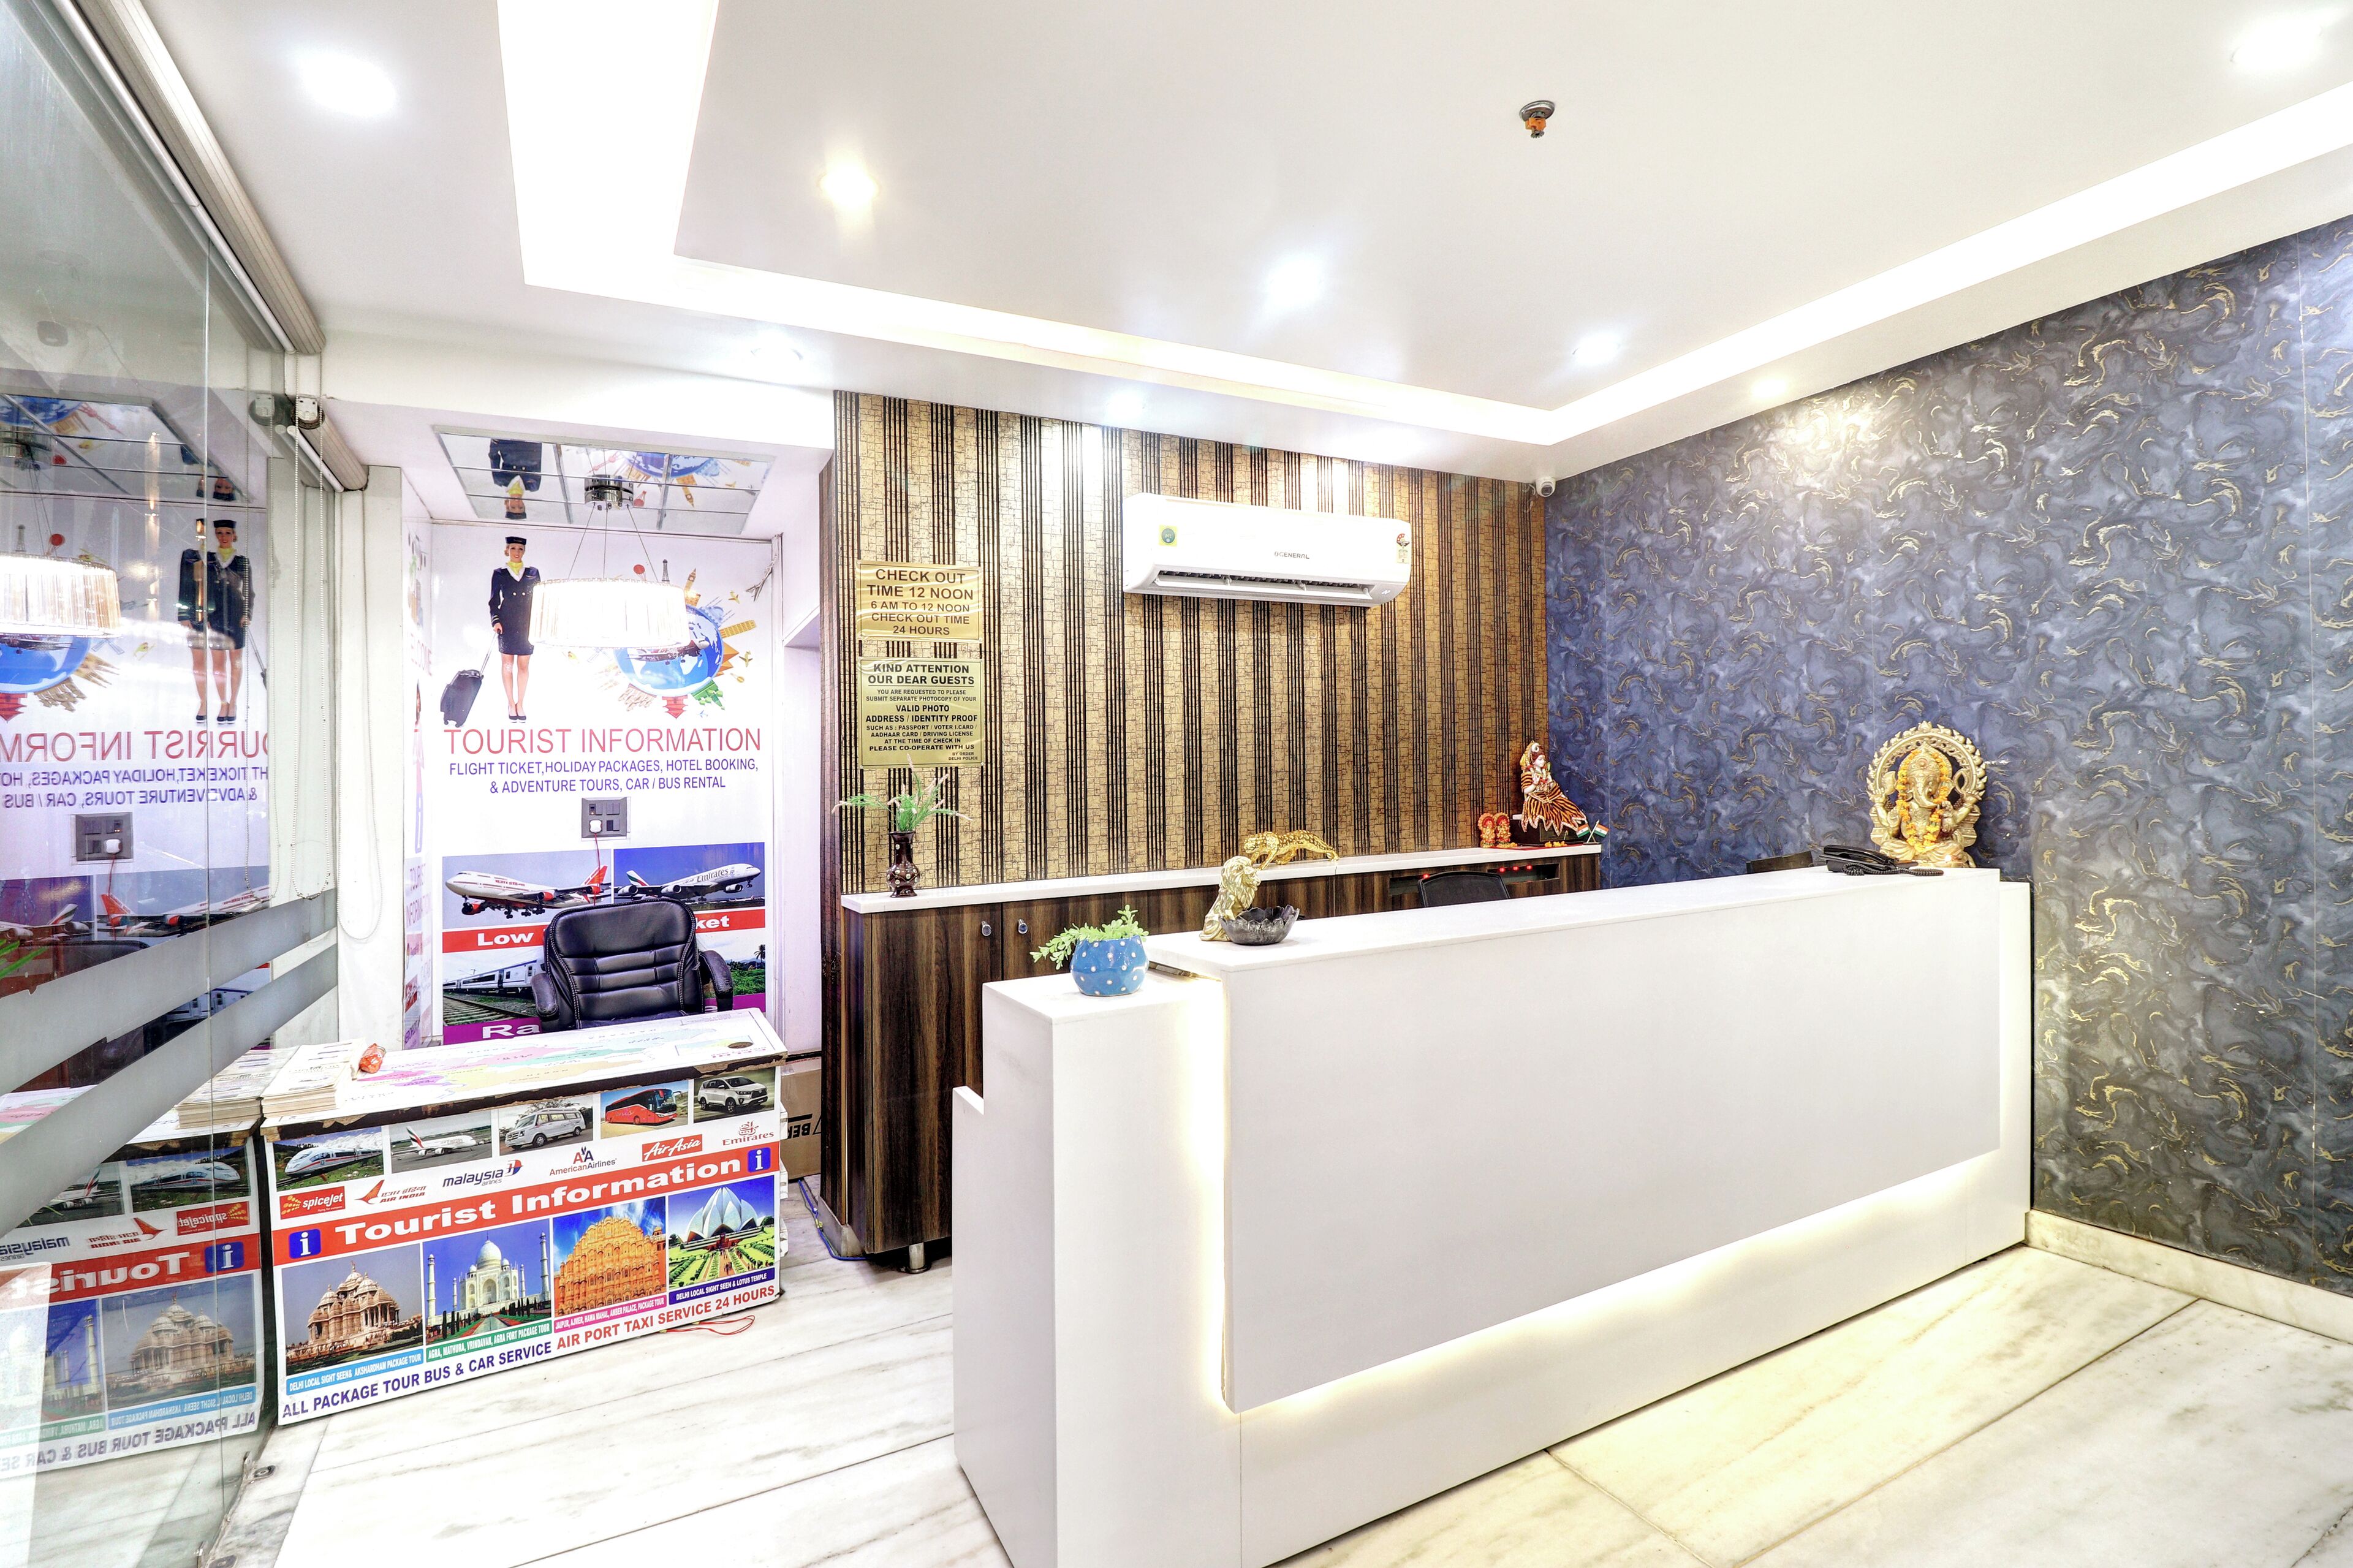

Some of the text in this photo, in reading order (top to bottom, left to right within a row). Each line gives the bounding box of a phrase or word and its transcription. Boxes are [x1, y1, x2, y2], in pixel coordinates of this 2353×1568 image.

[876, 569, 965, 583] CHECK OUT
[867, 585, 973, 600] TIME 12 NOON
[872, 613, 913, 622] CHECK
[910, 626, 950, 635] HOURS
[906, 664, 969, 673] ATTENTION
[868, 675, 893, 684] OUR
[444, 728, 760, 754] TOURIST INFORMATION
[450, 763, 495, 775] FLIGHT
[599, 760, 663, 774] PACKAGES,
[666, 759, 702, 771] HOTEL
[705, 759, 758, 772] BOOKING,
[490, 783, 499, 793] &
[502, 780, 576, 792] ADVENTURE
[579, 779, 623, 792] TOURS,
[626, 778, 649, 790] CAR
[659, 778, 680, 789] BUS
[684, 776, 726, 788] RENTAL
[697, 868, 729, 882] Emirates
[477, 915, 729, 946] Low ket
[483, 1025, 540, 1039] Ra
[722, 1131, 774, 1146] Emirates
[442, 1169, 504, 1187] malaysia
[302, 1192, 343, 1210] spiceJet
[335, 1199, 496, 1245] Tourist
[512, 1157, 741, 1214] Information
[691, 1288, 705, 1298] LOCAL
[705, 1285, 719, 1293] SIGHT
[737, 1277, 751, 1286] LOTUS
[751, 1273, 767, 1282] TEMPLE
[556, 1320, 569, 1329] JAIPUR,
[623, 1303, 637, 1314] PALACE,
[638, 1300, 654, 1310] PACKAGE
[557, 1285, 775, 1350] AIR PORT TAXI SERVICE 24 HOURS
[428, 1350, 442, 1359] AGRA,
[443, 1344, 466, 1355] MATHURA,
[494, 1335, 506, 1344] AGRA
[506, 1331, 517, 1341] FORT
[518, 1327, 537, 1338] PACKAGE
[538, 1324, 550, 1333] TOUR
[282, 1342, 551, 1418] ALL PACKAGE TOUR BUS & CAR SERVICE
[289, 1381, 304, 1392] DELHI
[305, 1378, 320, 1388] LOCAL
[321, 1374, 335, 1384] SIGHT
[355, 1363, 386, 1377] AKSHARDHAM
[387, 1357, 408, 1369] PACKAGE
[408, 1354, 421, 1364] TOUR
